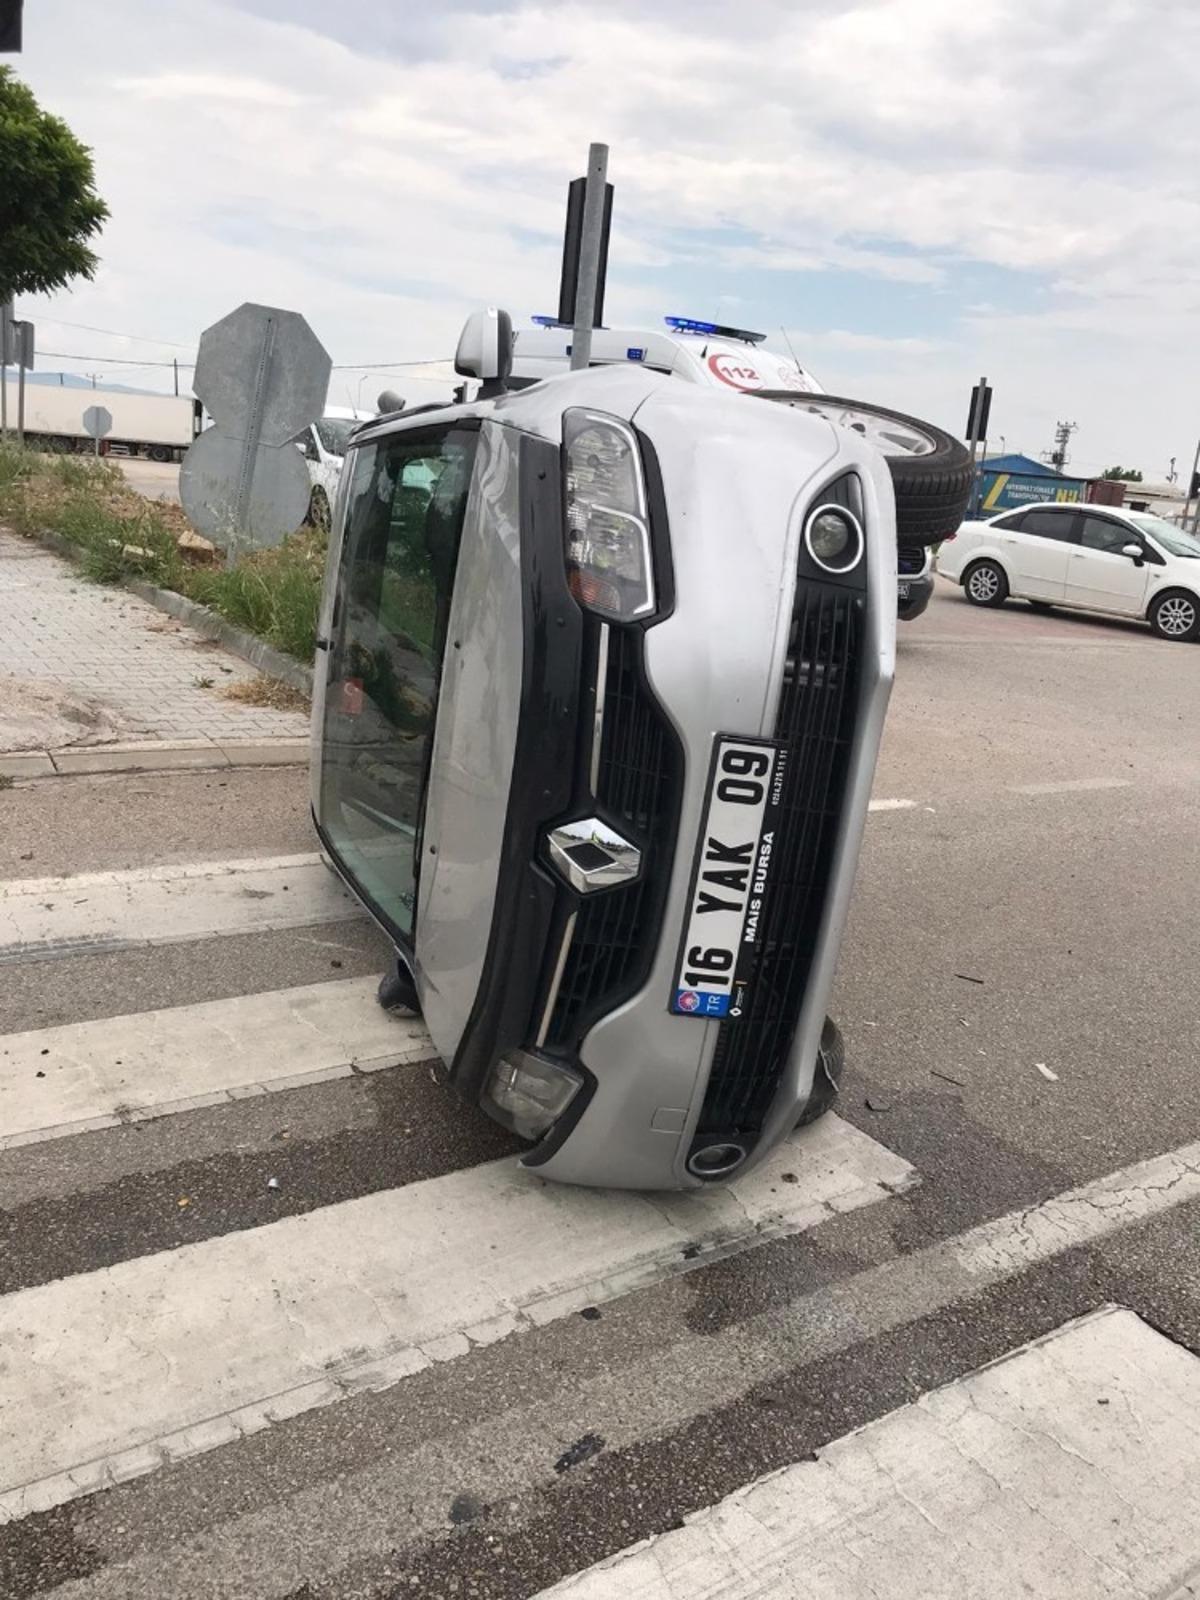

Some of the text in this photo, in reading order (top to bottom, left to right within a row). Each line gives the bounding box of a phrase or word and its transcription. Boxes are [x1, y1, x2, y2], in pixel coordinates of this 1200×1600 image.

[721, 366, 760, 380] 112
[684, 749, 769, 1012] TR 16 YAK 09
[753, 831, 774, 894] BURSA
